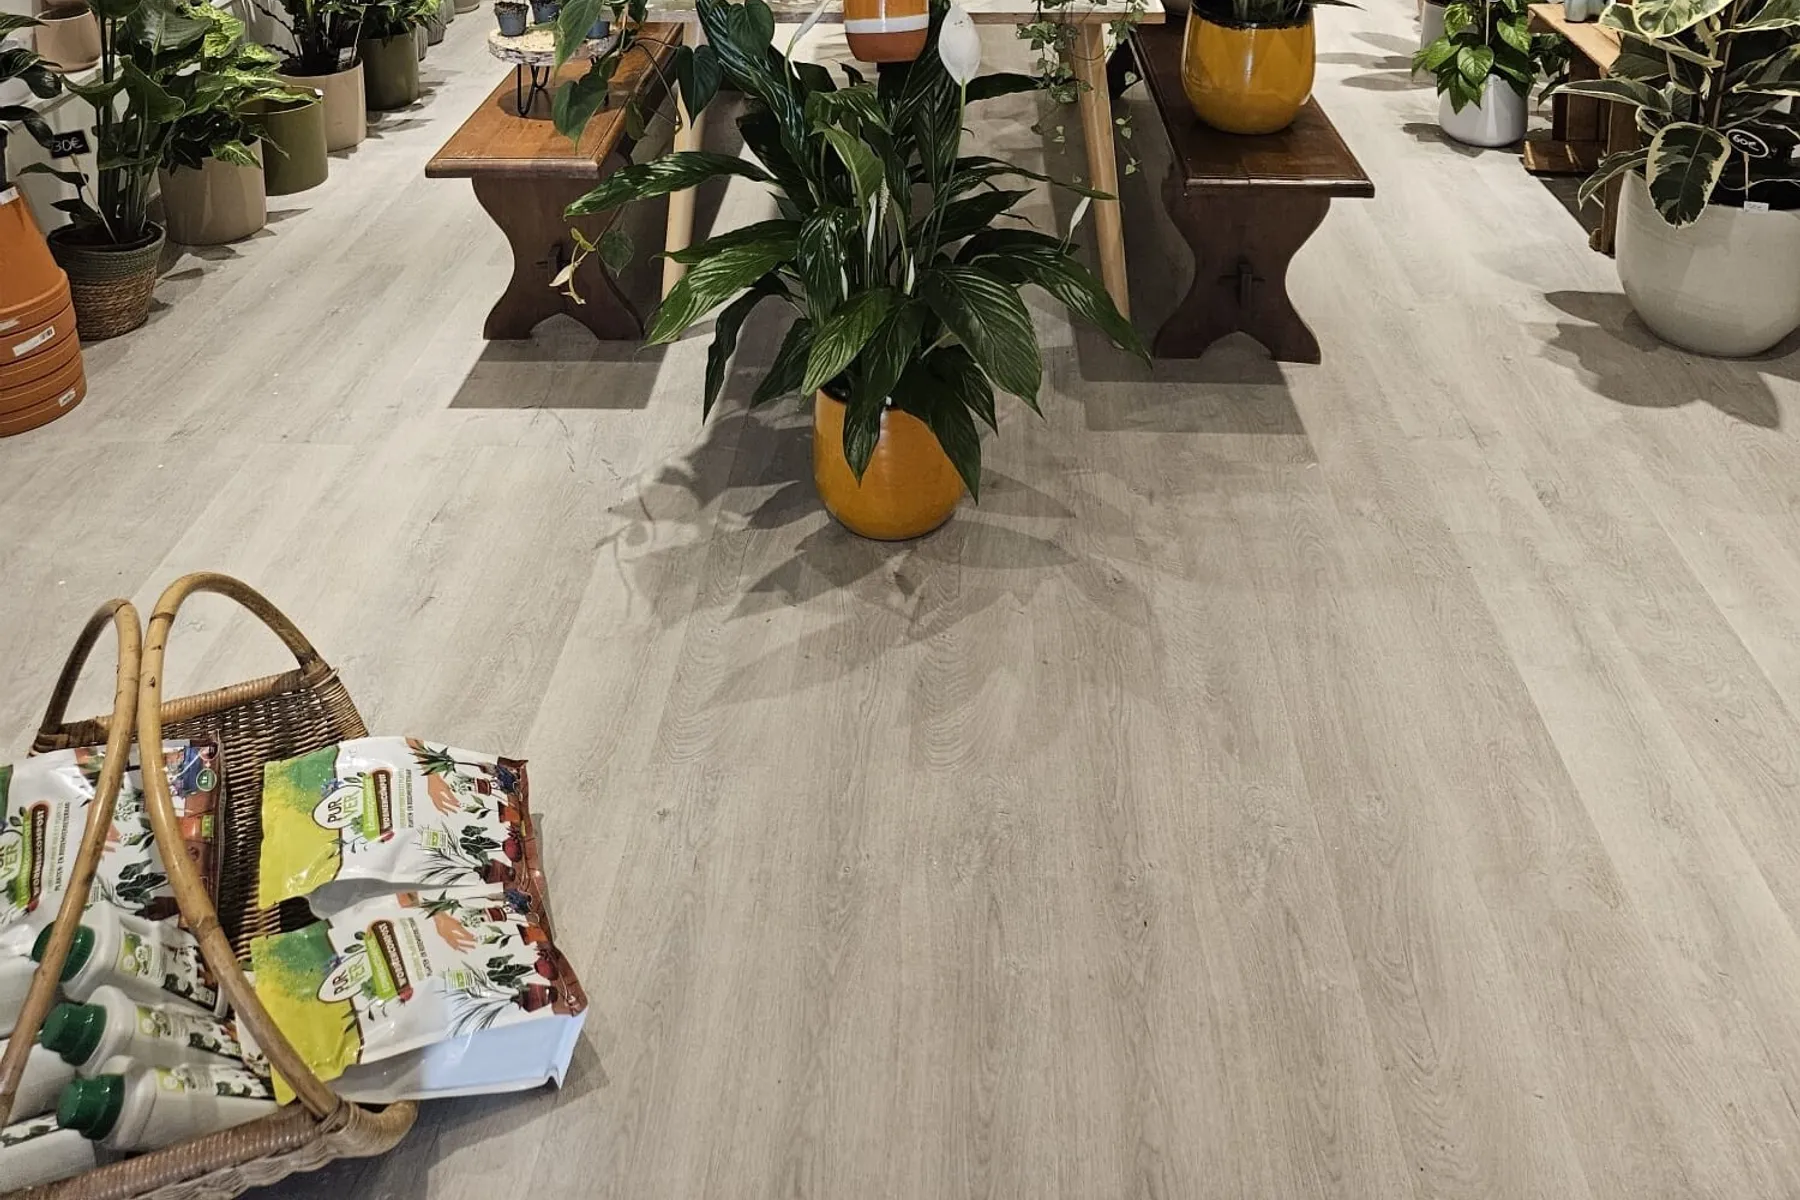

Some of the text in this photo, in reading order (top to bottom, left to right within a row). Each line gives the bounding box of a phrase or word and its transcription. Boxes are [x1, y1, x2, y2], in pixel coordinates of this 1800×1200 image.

[52, 136, 84, 153] 30€
[1732, 134, 1760, 152] 60€
[327, 797, 342, 823] PUR
[343, 789, 360, 820] VER
[1, 840, 20, 879] VER
